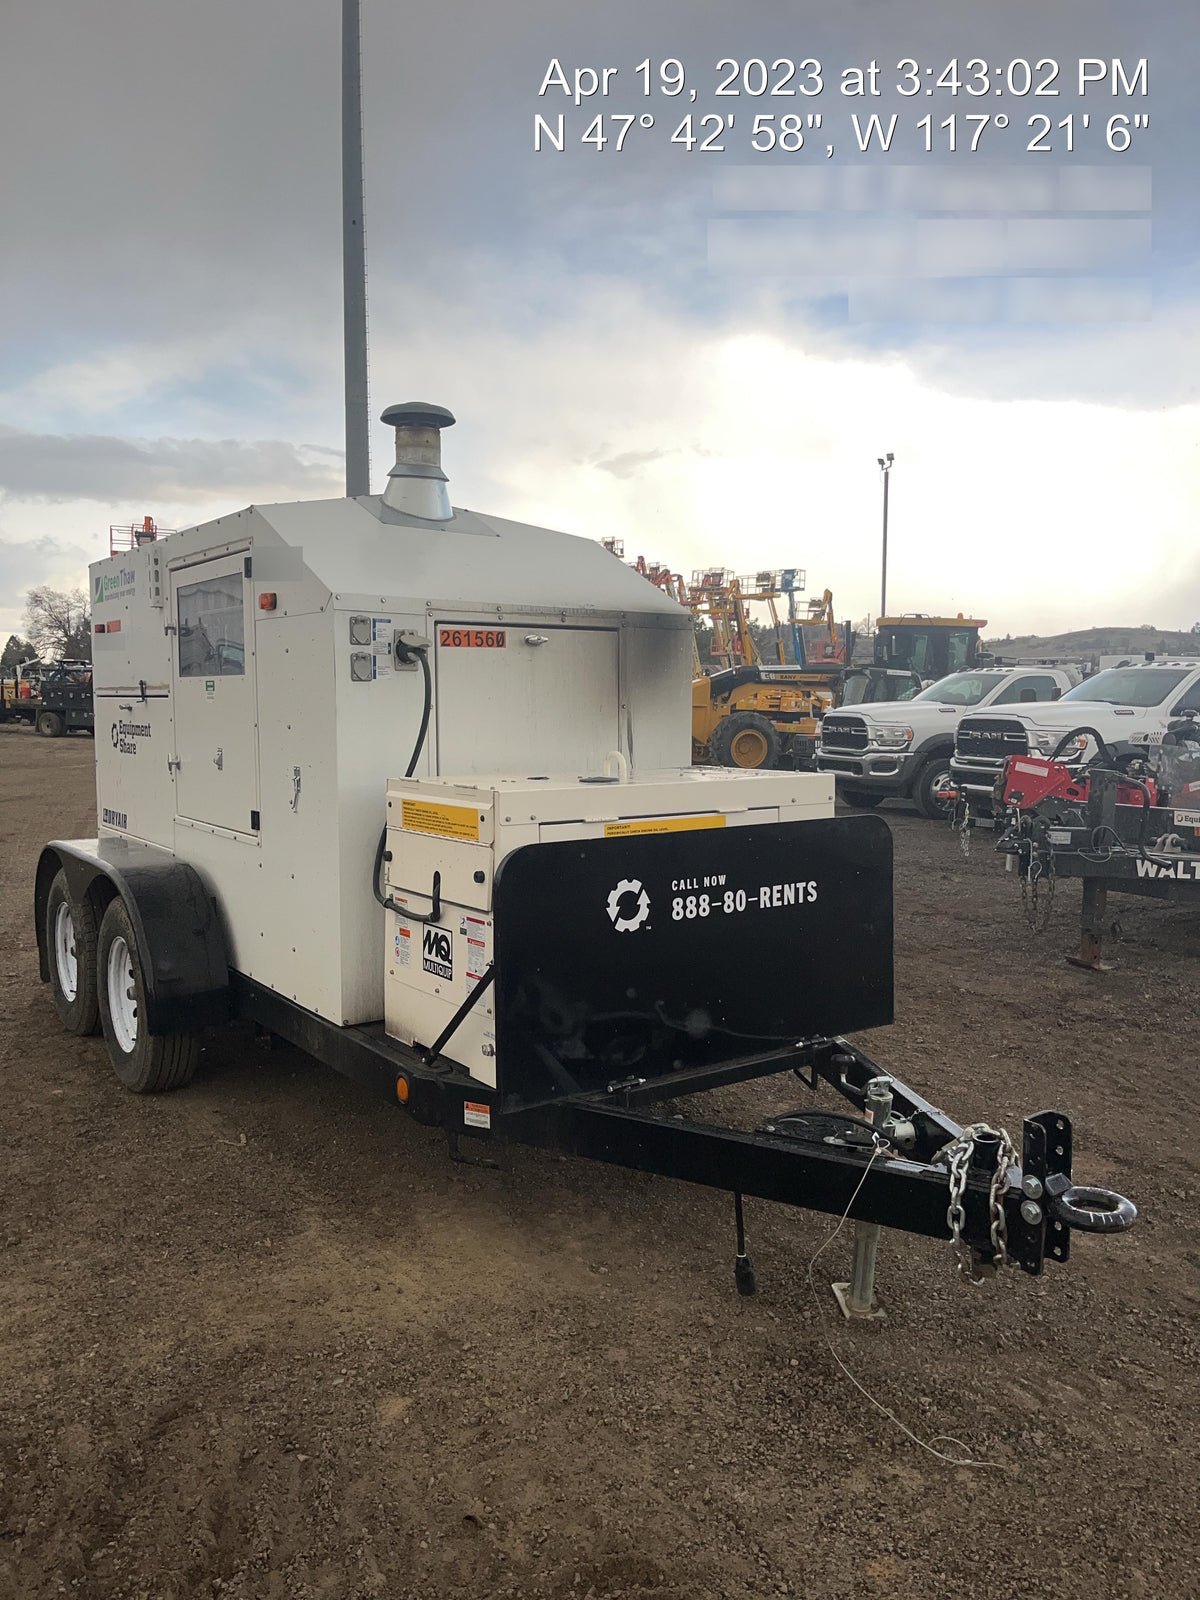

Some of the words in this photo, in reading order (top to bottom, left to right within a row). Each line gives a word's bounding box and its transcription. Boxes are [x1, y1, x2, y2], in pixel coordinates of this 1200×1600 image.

[440, 630, 506, 647] 261560
[118, 720, 151, 739] Equipment
[119, 738, 137, 755] Share
[671, 878, 699, 891] CALL
[703, 874, 726, 887] NOW
[671, 880, 818, 921] 888-80-RENTS
[423, 929, 452, 965] MQ
[423, 958, 452, 979] MULTIQUIP
